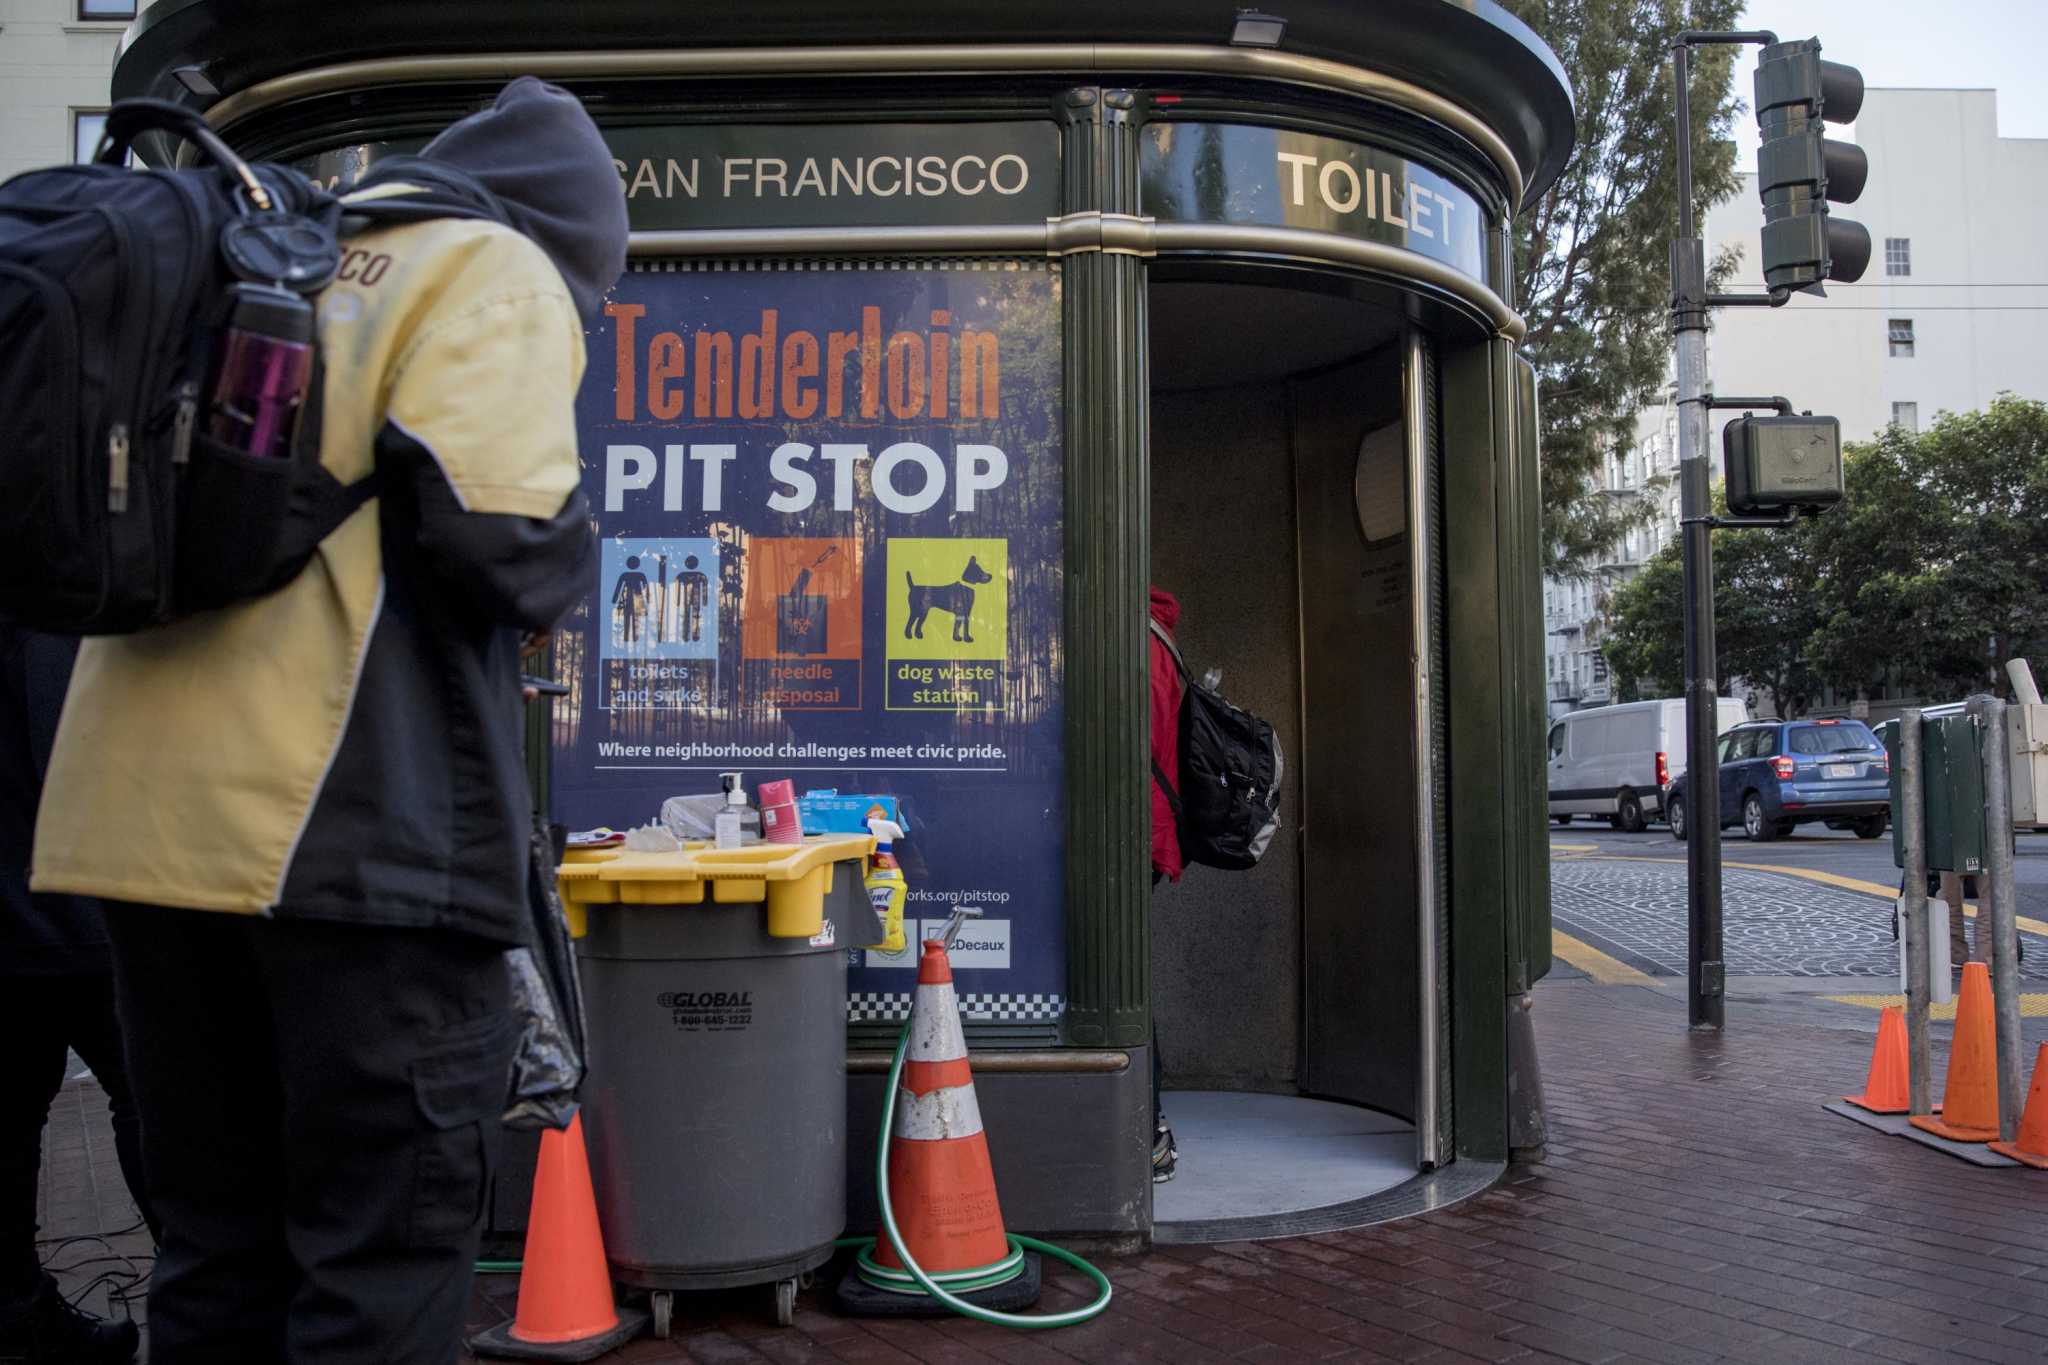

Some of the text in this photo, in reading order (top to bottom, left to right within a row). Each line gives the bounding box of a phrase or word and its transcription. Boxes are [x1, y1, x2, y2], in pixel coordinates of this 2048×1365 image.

[723, 154, 1029, 197] FRANCISCO
[1277, 152, 1456, 246] TOILET
[604, 303, 1000, 421] Tenderloin
[605, 442, 1009, 514] PIT STOP
[629, 664, 690, 680] toilets
[770, 664, 833, 680] needle
[897, 664, 995, 683] dog waste
[616, 687, 650, 703] and
[762, 687, 841, 706] disposal
[912, 687, 980, 704] station
[598, 742, 1007, 762] Where neighborhood challenges meet civic pride.
[906, 888, 1010, 905] orks.org/pitstop
[949, 937, 1006, 952] Decaux
[672, 991, 753, 1008] GLOBAL
